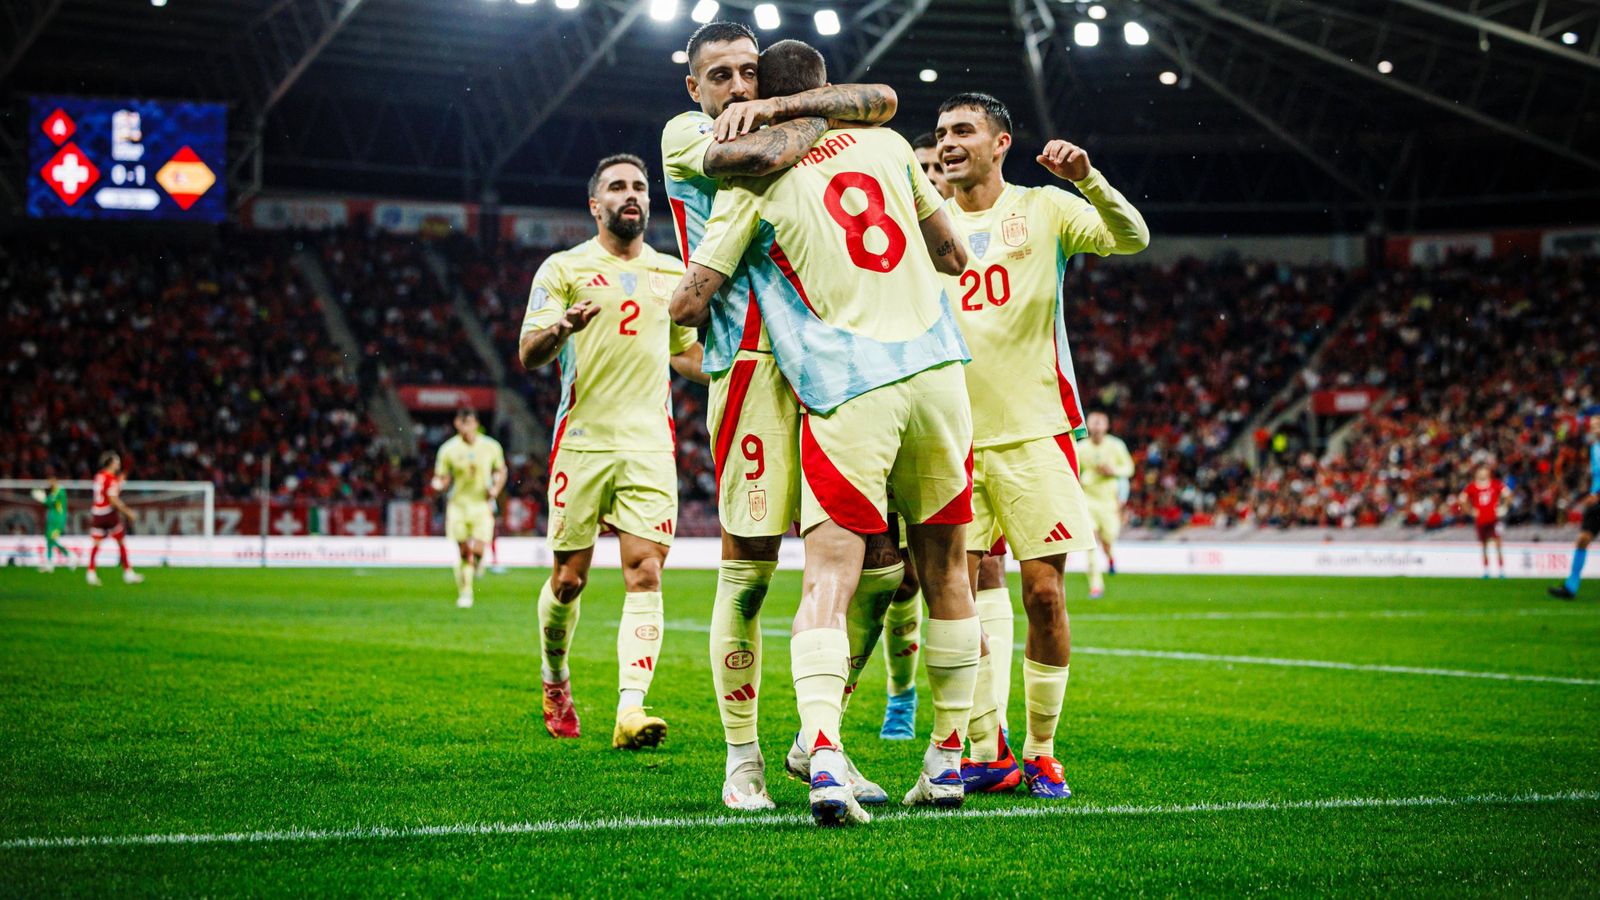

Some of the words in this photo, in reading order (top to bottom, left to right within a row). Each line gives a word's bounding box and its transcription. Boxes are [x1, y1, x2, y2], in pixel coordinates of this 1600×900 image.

[823, 171, 907, 273] 8
[960, 264, 1010, 311] 20
[619, 300, 640, 336] 2
[741, 433, 765, 480] 9
[554, 471, 568, 508] 2
